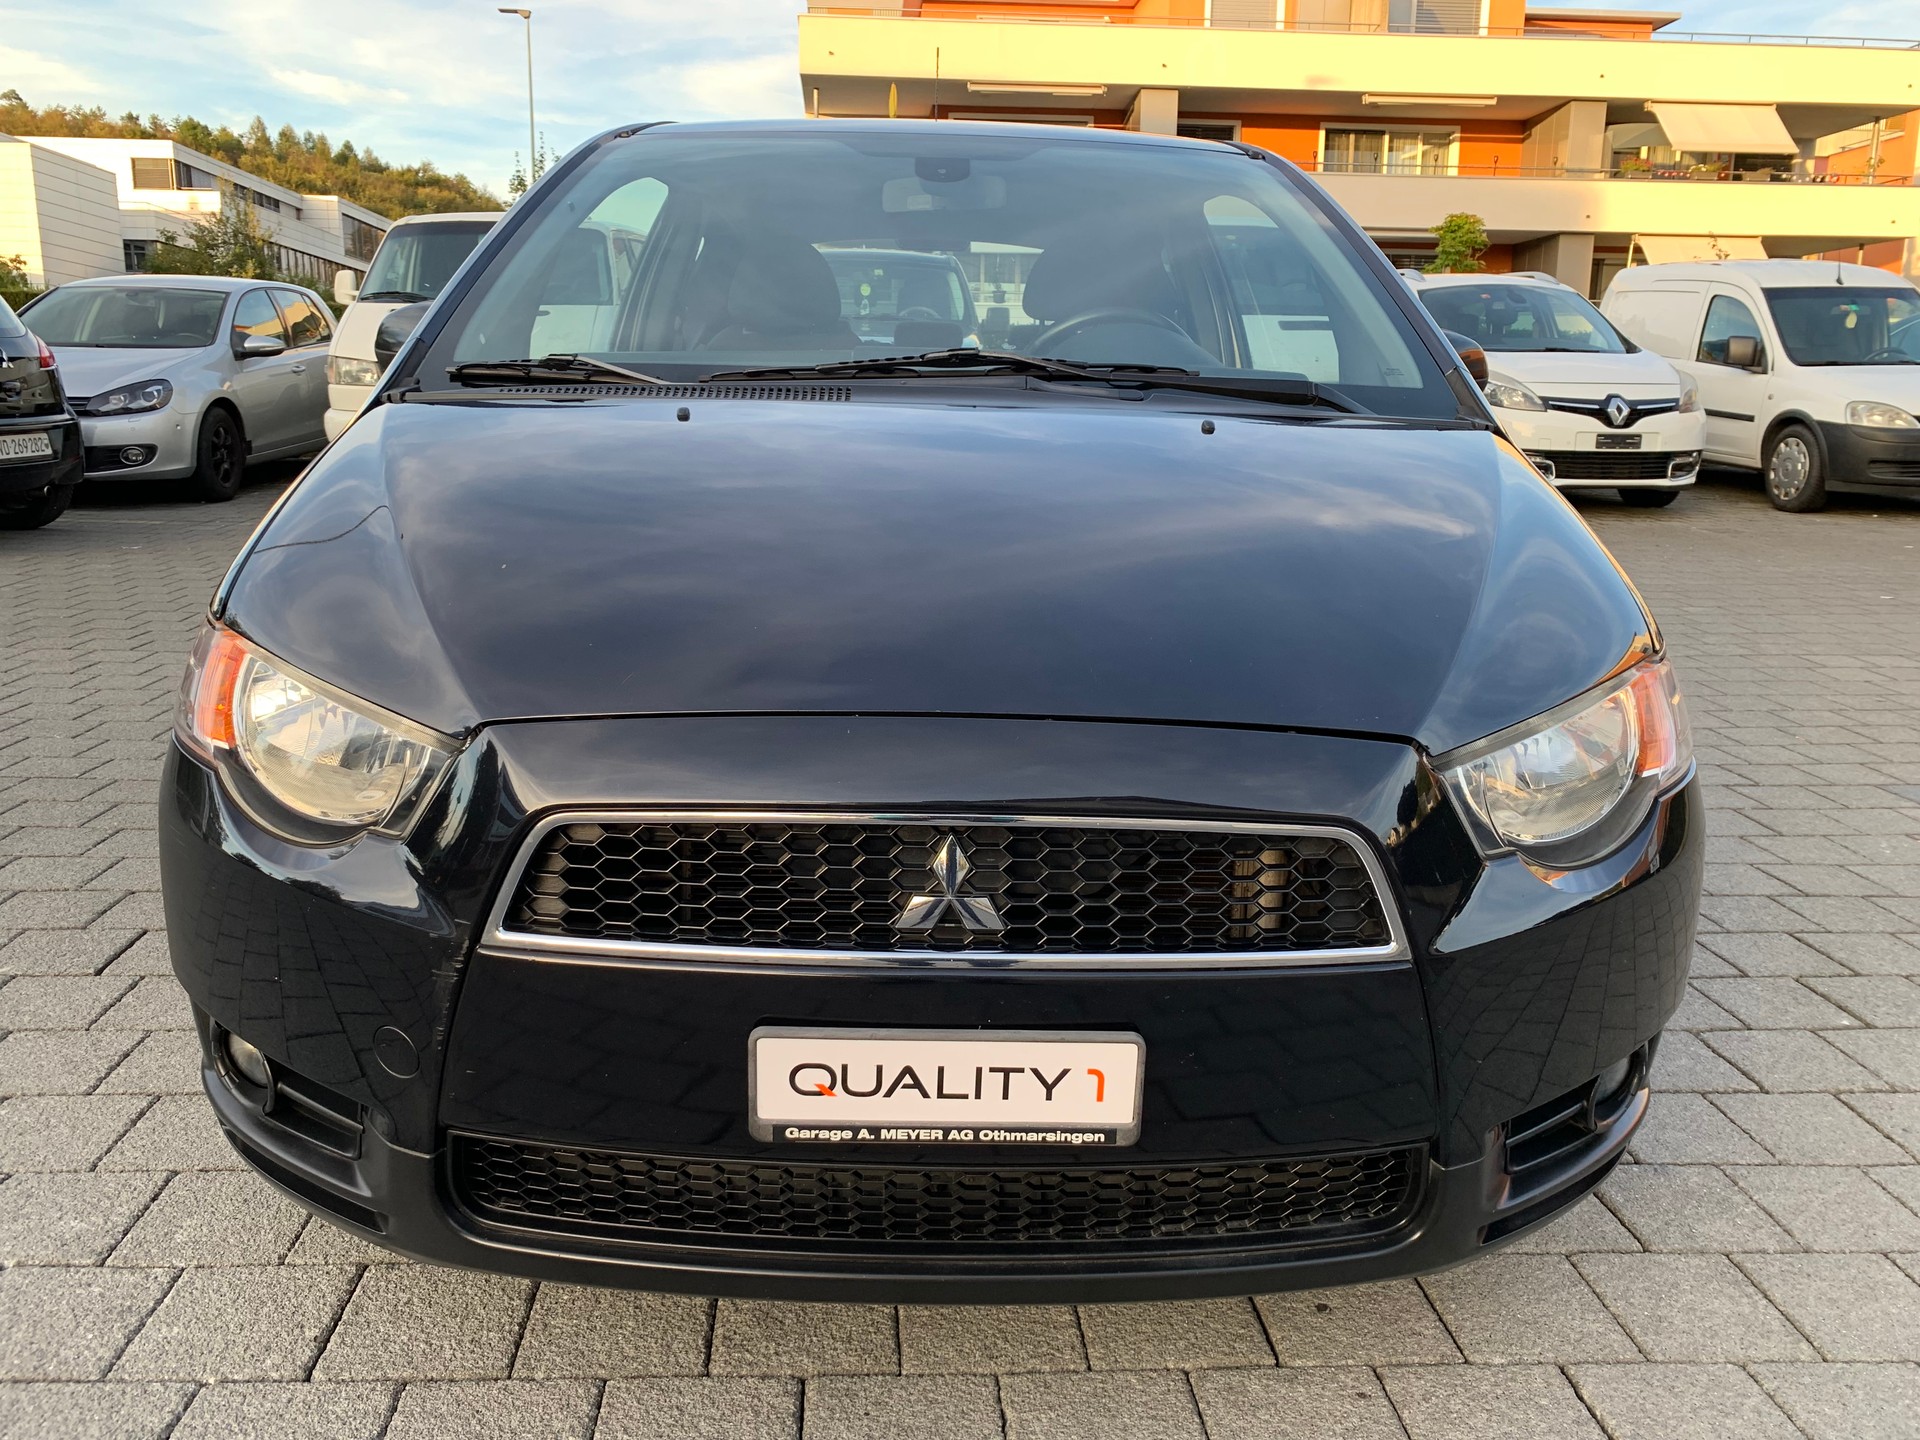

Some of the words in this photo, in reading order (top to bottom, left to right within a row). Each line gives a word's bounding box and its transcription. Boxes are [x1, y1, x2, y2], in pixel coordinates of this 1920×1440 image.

[788, 1062, 1072, 1102] QUALITY
[1086, 1068, 1105, 1103] 1
[785, 1127, 853, 1141] Garage
[857, 1128, 875, 1140] A.
[880, 1128, 944, 1140] MEYER
[947, 1129, 974, 1141] AG
[979, 1129, 1105, 1144] Othmarsingen
